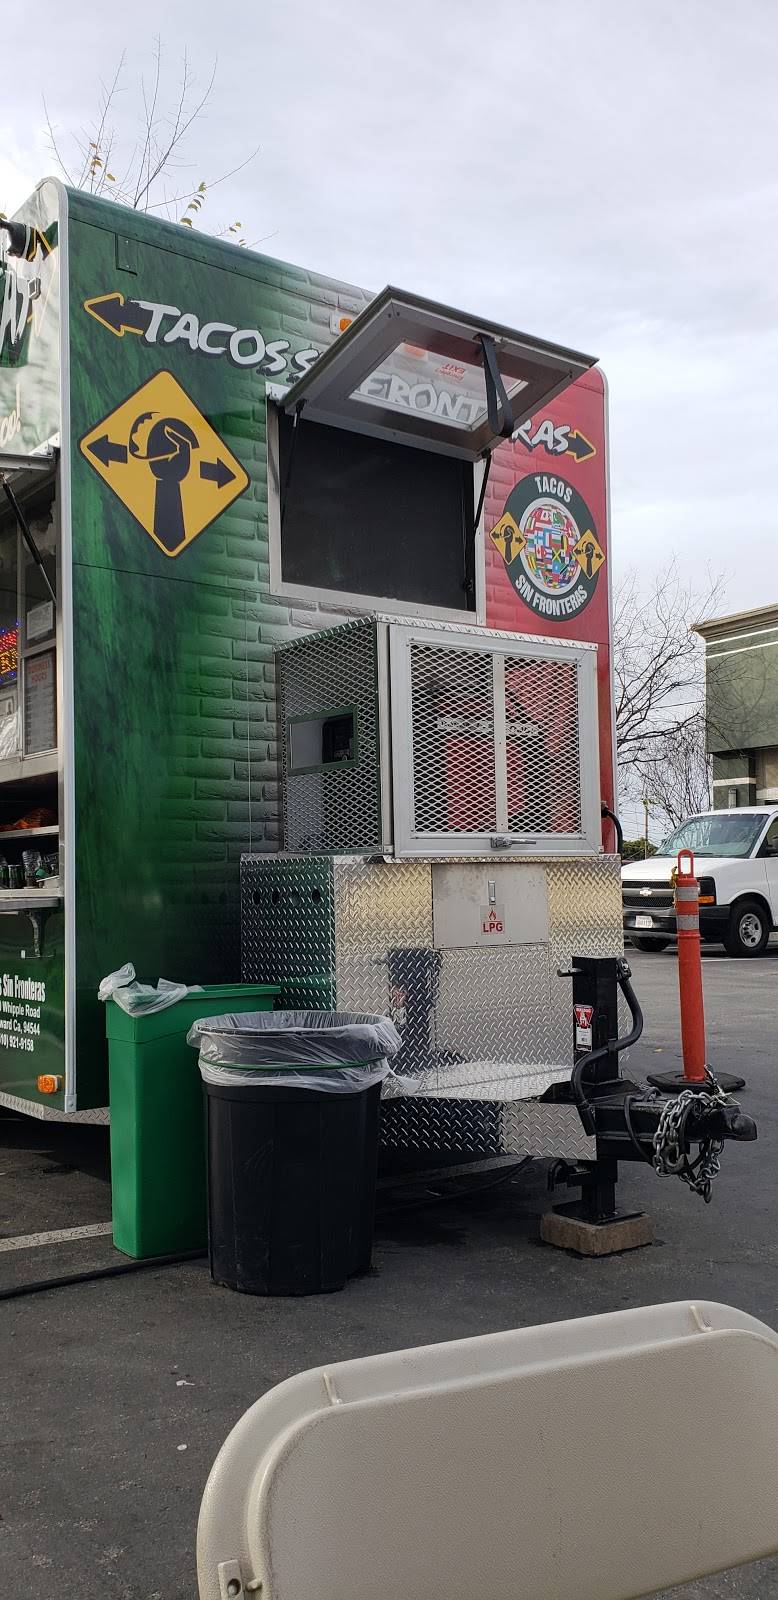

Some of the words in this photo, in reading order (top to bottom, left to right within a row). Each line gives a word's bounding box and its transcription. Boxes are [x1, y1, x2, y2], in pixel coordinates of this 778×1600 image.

[130, 300, 291, 373] TACOS
[534, 476, 573, 503] TACOS
[515, 574, 533, 599] SIN
[532, 584, 588, 616] FRONTERAS
[483, 922, 503, 933] LPG
[2, 973, 14, 997] Sin
[14, 975, 46, 1002] Fronteras
[2, 1000, 24, 1017] Whipple
[25, 1004, 41, 1019] Road
[23, 1021, 41, 1036] 94544
